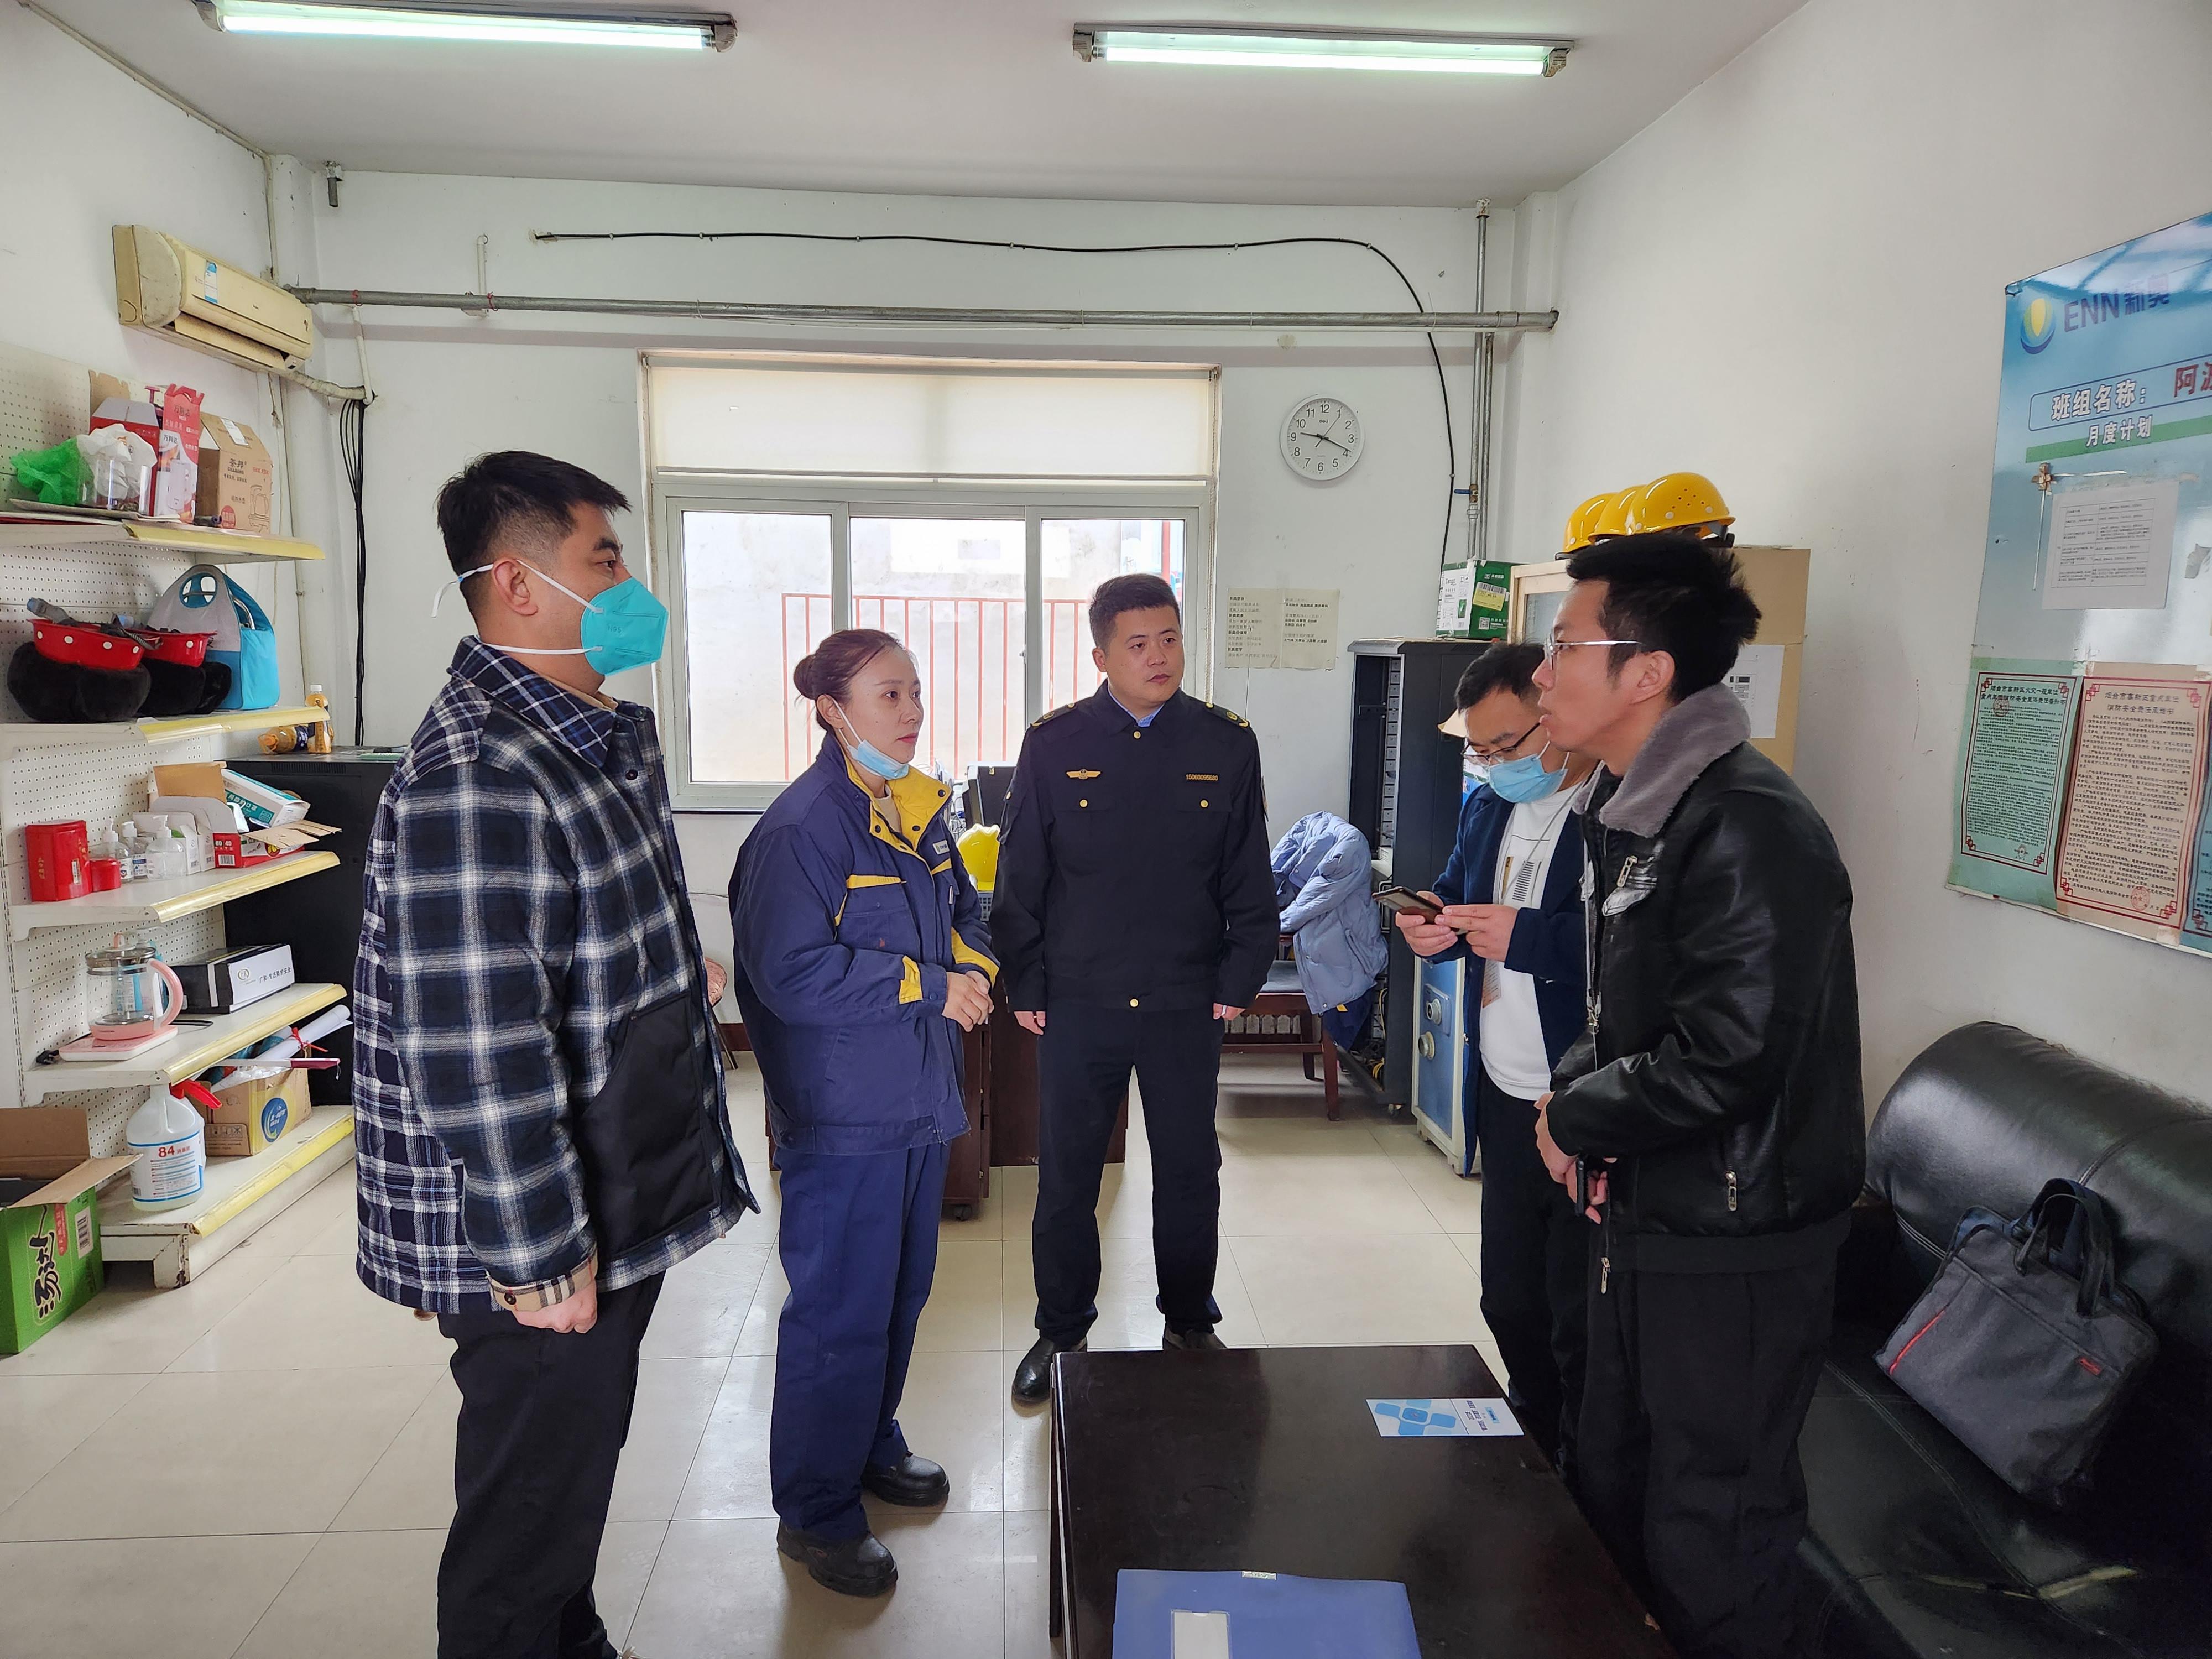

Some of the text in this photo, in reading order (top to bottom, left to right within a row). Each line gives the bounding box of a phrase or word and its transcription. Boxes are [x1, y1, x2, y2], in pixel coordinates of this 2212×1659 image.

[1306, 408, 1314, 418] 11
[1319, 404, 1330, 414] 12
[1296, 419, 1306, 429] 10
[1345, 420, 1352, 430] 2
[2086, 414, 2153, 447] 月度计划
[1290, 432, 1297, 442] 9
[1348, 434, 1354, 444] 3
[1294, 447, 1300, 457] 8
[1305, 457, 1311, 467] 7
[1317, 462, 1324, 472] 6
[1332, 458, 1338, 468] 5
[158, 1145, 175, 1158] 84
